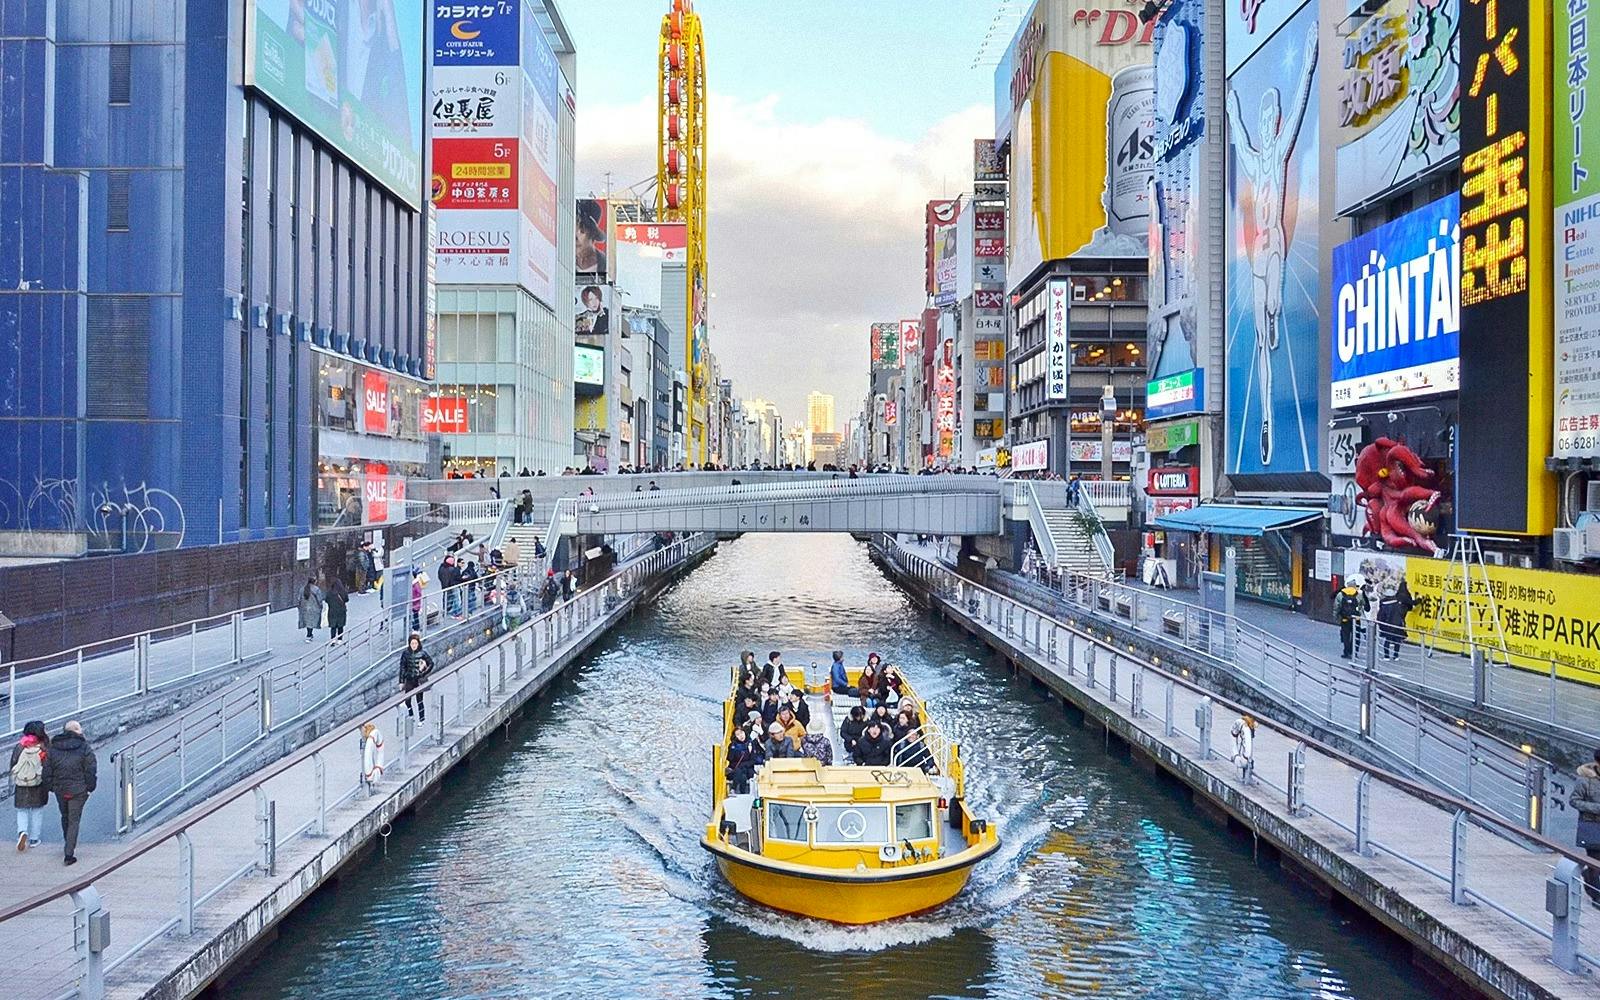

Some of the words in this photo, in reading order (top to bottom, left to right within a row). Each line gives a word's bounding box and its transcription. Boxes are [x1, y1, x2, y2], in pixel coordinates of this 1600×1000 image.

[437, 5, 494, 18] カラオケ
[1460, 0, 1528, 307] ーパー玉出
[1565, 227, 1588, 244] Real
[1565, 245, 1594, 261] Estate
[1564, 292, 1597, 307] SERVICE
[366, 390, 386, 413] SALE
[423, 408, 464, 423] SALE
[1160, 473, 1187, 488] LOTTERIA
[367, 480, 386, 502] SALE
